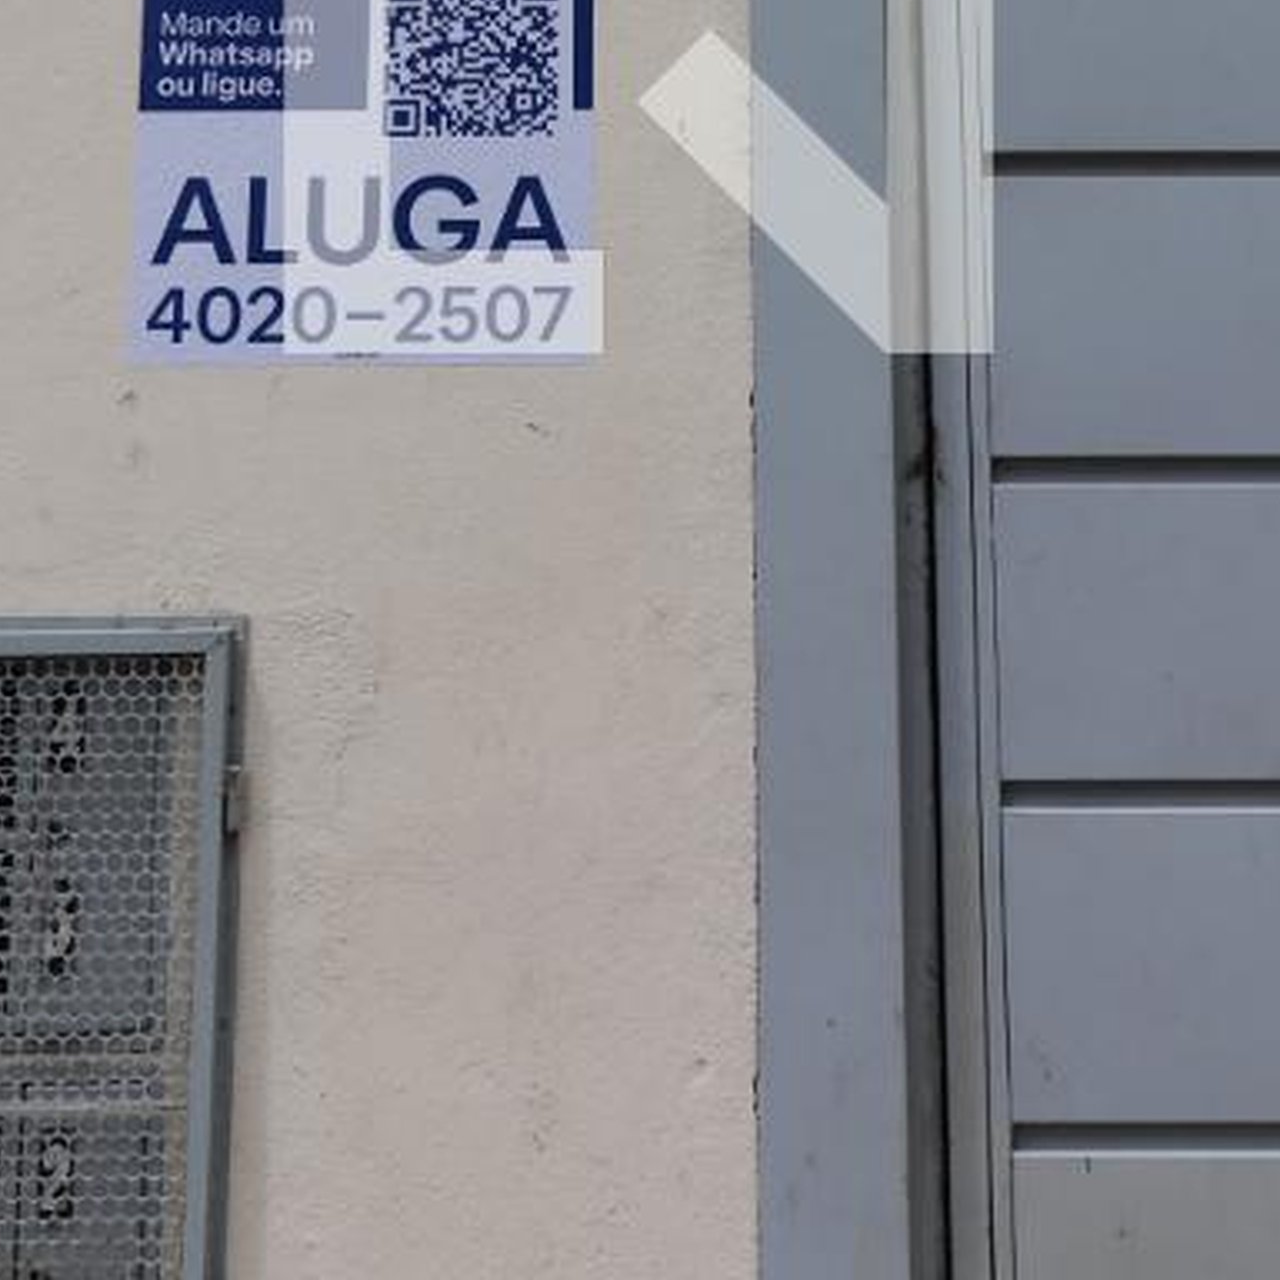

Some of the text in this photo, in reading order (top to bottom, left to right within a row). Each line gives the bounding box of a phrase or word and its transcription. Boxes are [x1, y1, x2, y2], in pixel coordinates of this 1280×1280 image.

[160, 12, 315, 37] Mande um
[158, 41, 315, 72] Whatsapp
[156, 70, 283, 101] ou ligue.
[149, 174, 571, 266] ALUGA
[145, 284, 574, 345] 4020-2507
